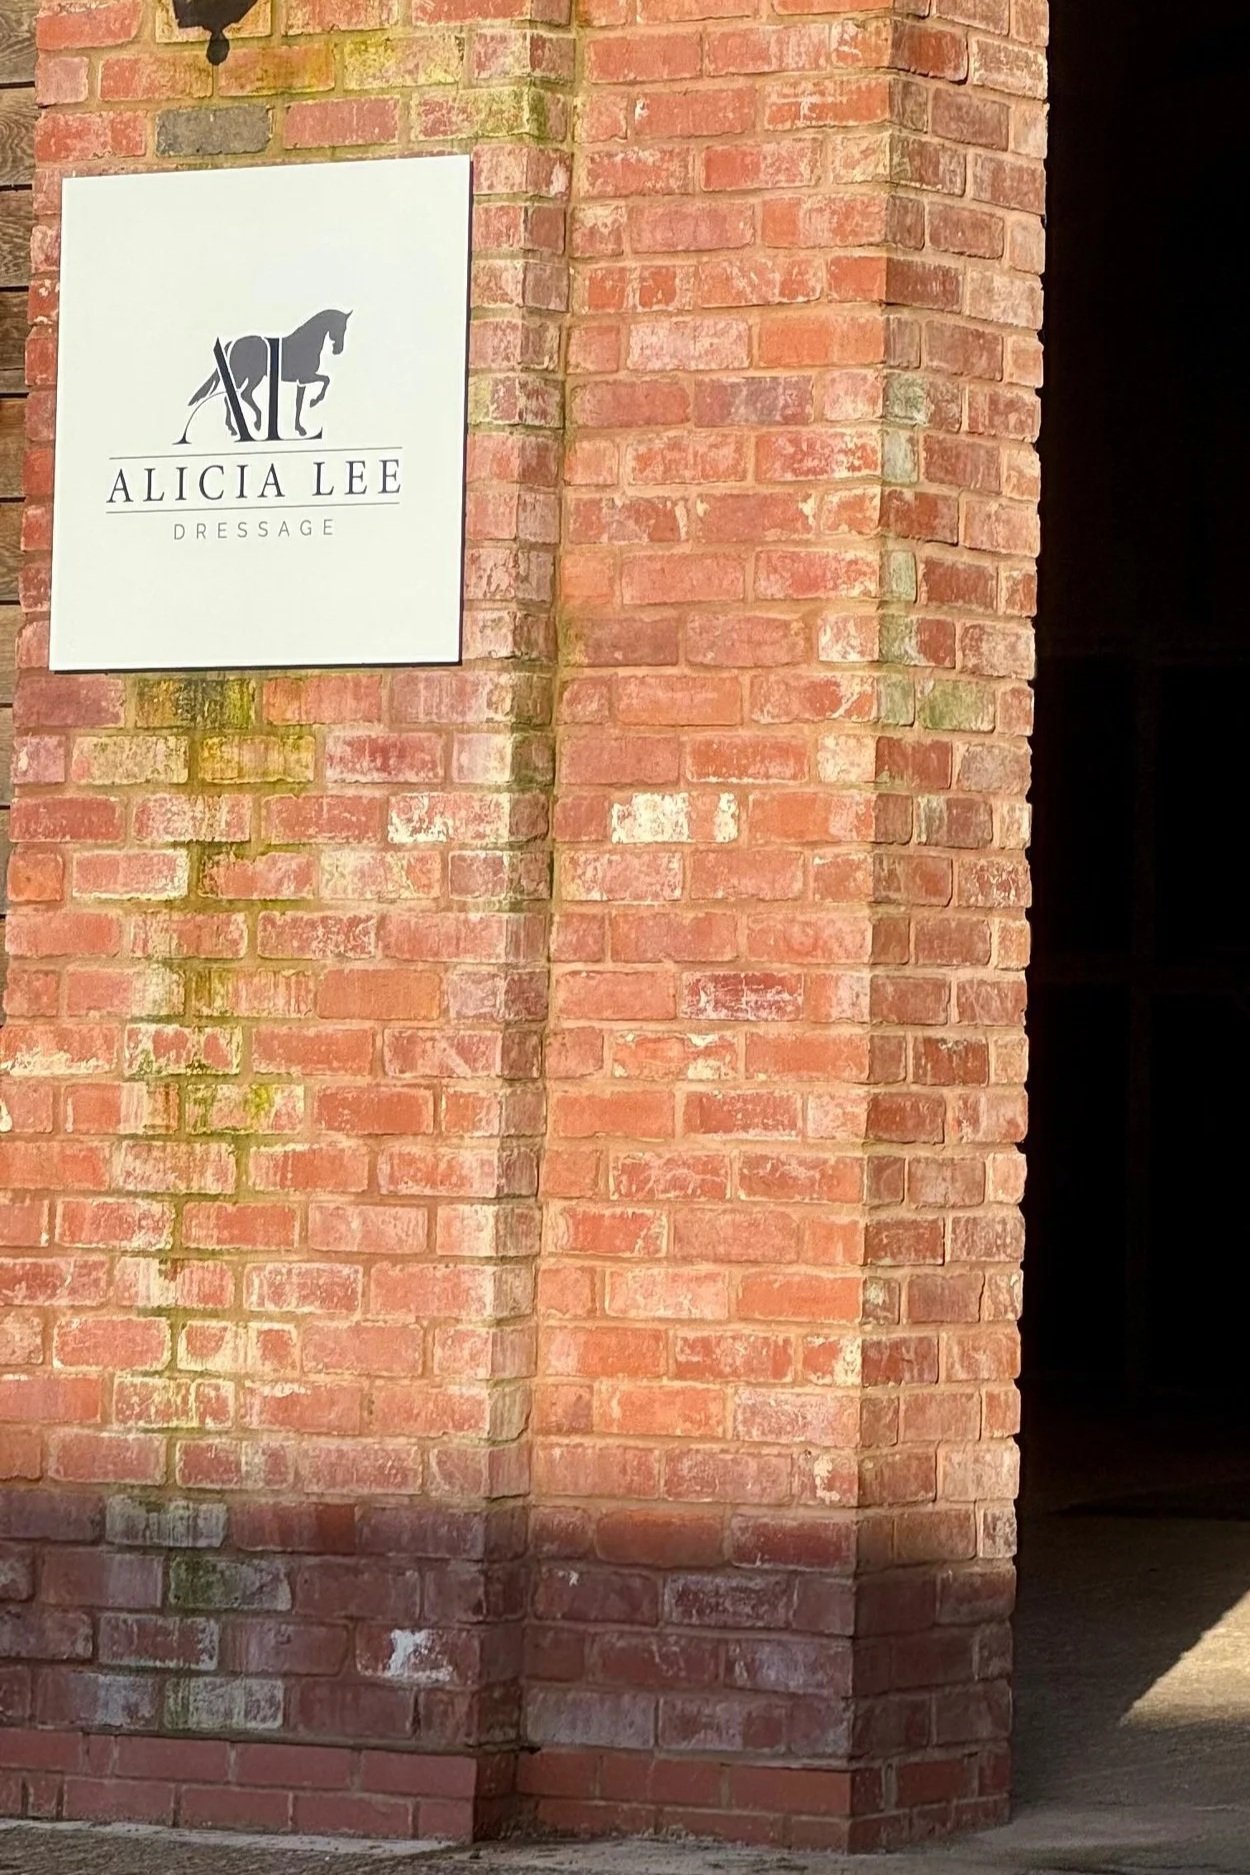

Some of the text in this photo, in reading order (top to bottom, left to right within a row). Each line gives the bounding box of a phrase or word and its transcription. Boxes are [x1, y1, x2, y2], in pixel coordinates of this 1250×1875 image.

[106, 459, 402, 503] ALICIA LEE
[173, 518, 334, 541] DRESSAGE
